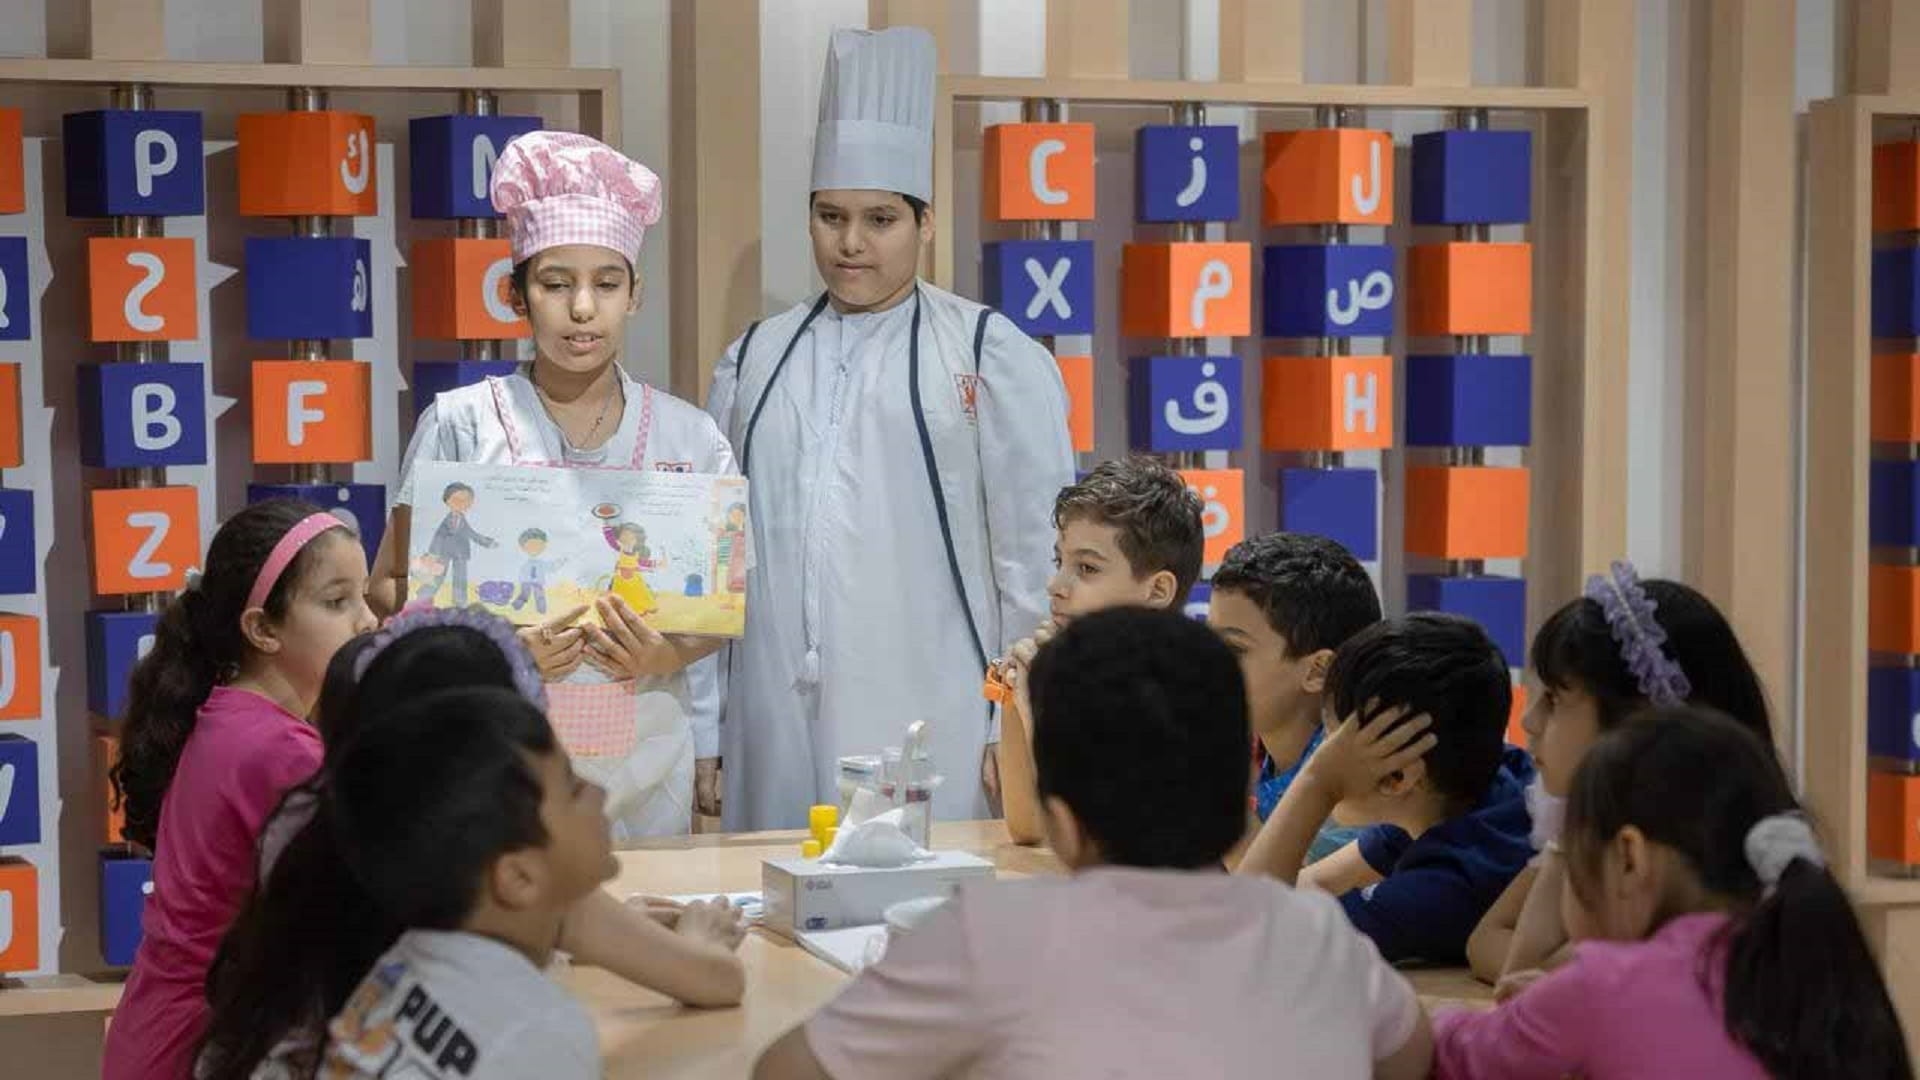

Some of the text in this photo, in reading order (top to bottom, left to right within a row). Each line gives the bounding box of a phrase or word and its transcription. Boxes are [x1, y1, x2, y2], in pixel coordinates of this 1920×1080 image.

[134, 129, 178, 197] P
[1029, 139, 1069, 204] C
[1024, 257, 1072, 320] X
[1327, 271, 1393, 325] ص
[131, 383, 182, 450] B
[287, 380, 327, 446] F
[1165, 362, 1229, 434] ف
[1343, 371, 1377, 433] H
[126, 511, 172, 578] Z
[394, 983, 478, 1077] PUP
